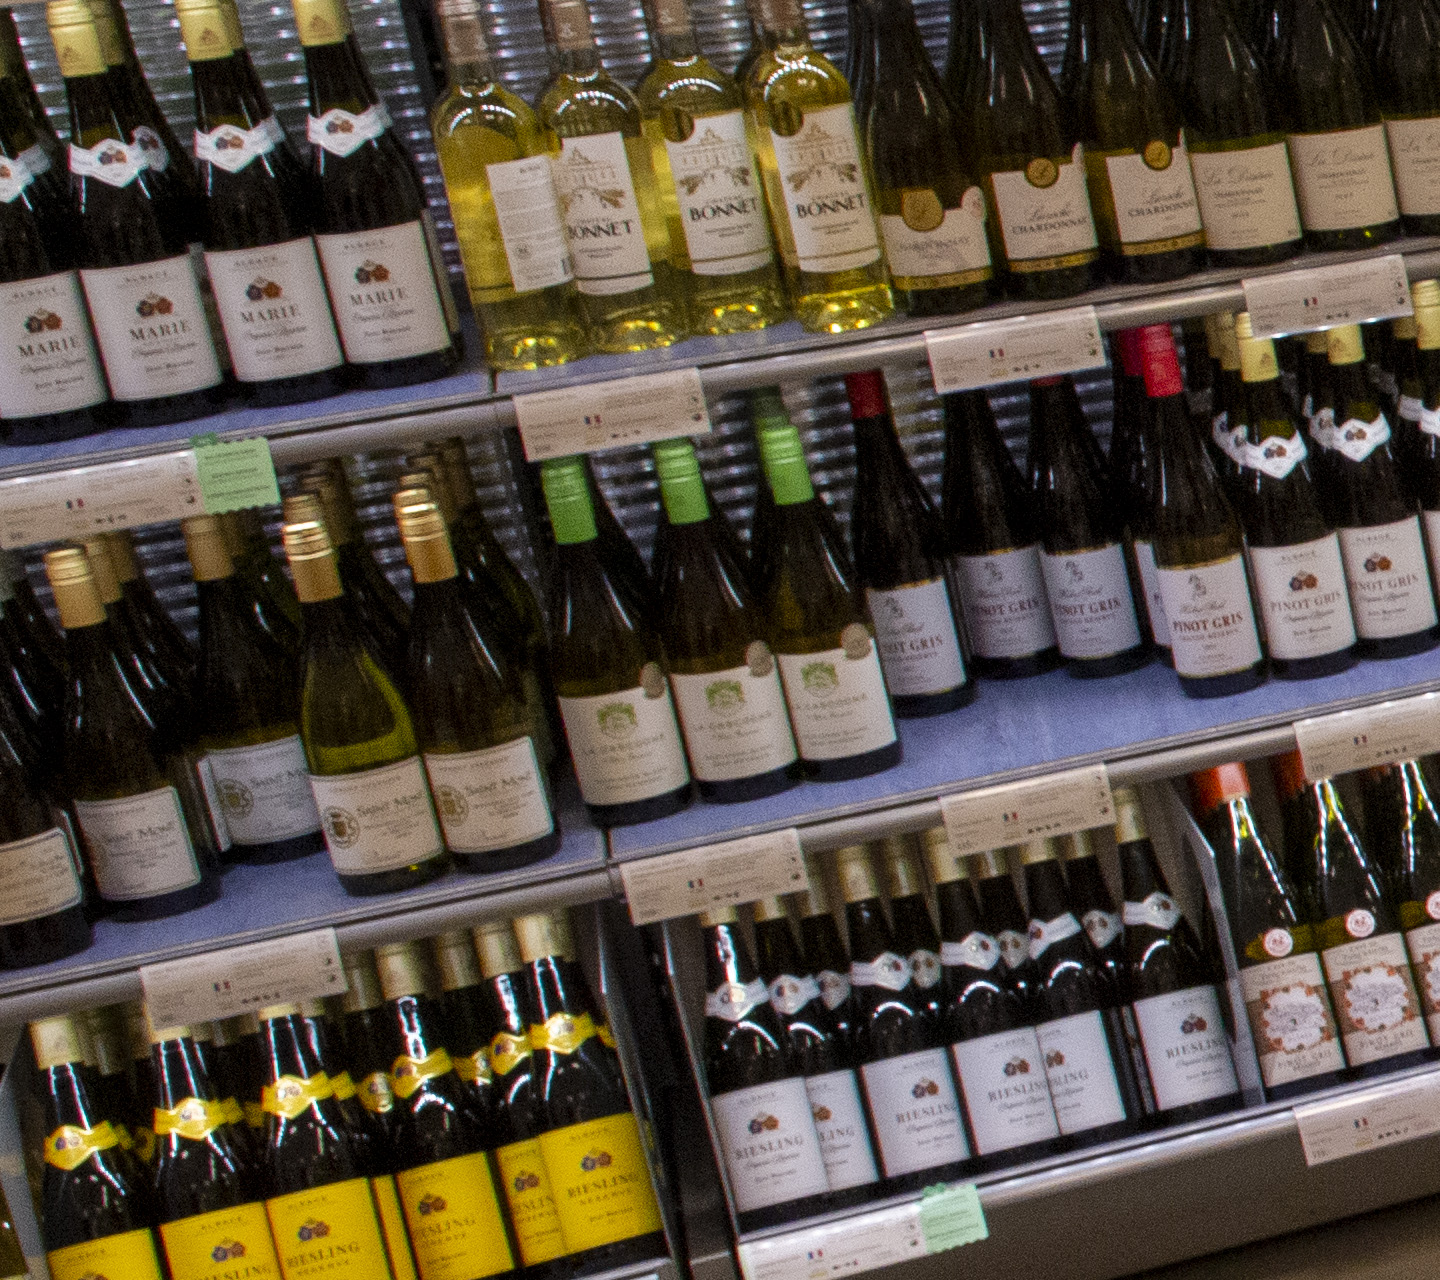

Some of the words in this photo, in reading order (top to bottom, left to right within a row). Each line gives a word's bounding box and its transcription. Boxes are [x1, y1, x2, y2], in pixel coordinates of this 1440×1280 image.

[689, 195, 759, 222] BONNET
[795, 192, 866, 218] BONNET
[350, 286, 410, 308] MARIE
[239, 304, 298, 326] MARIE
[129, 319, 190, 343] MARIE
[18, 334, 81, 359] MARIE
[734, 1132, 804, 1161] RIESLING
[285, 1241, 361, 1269] RIESLING
